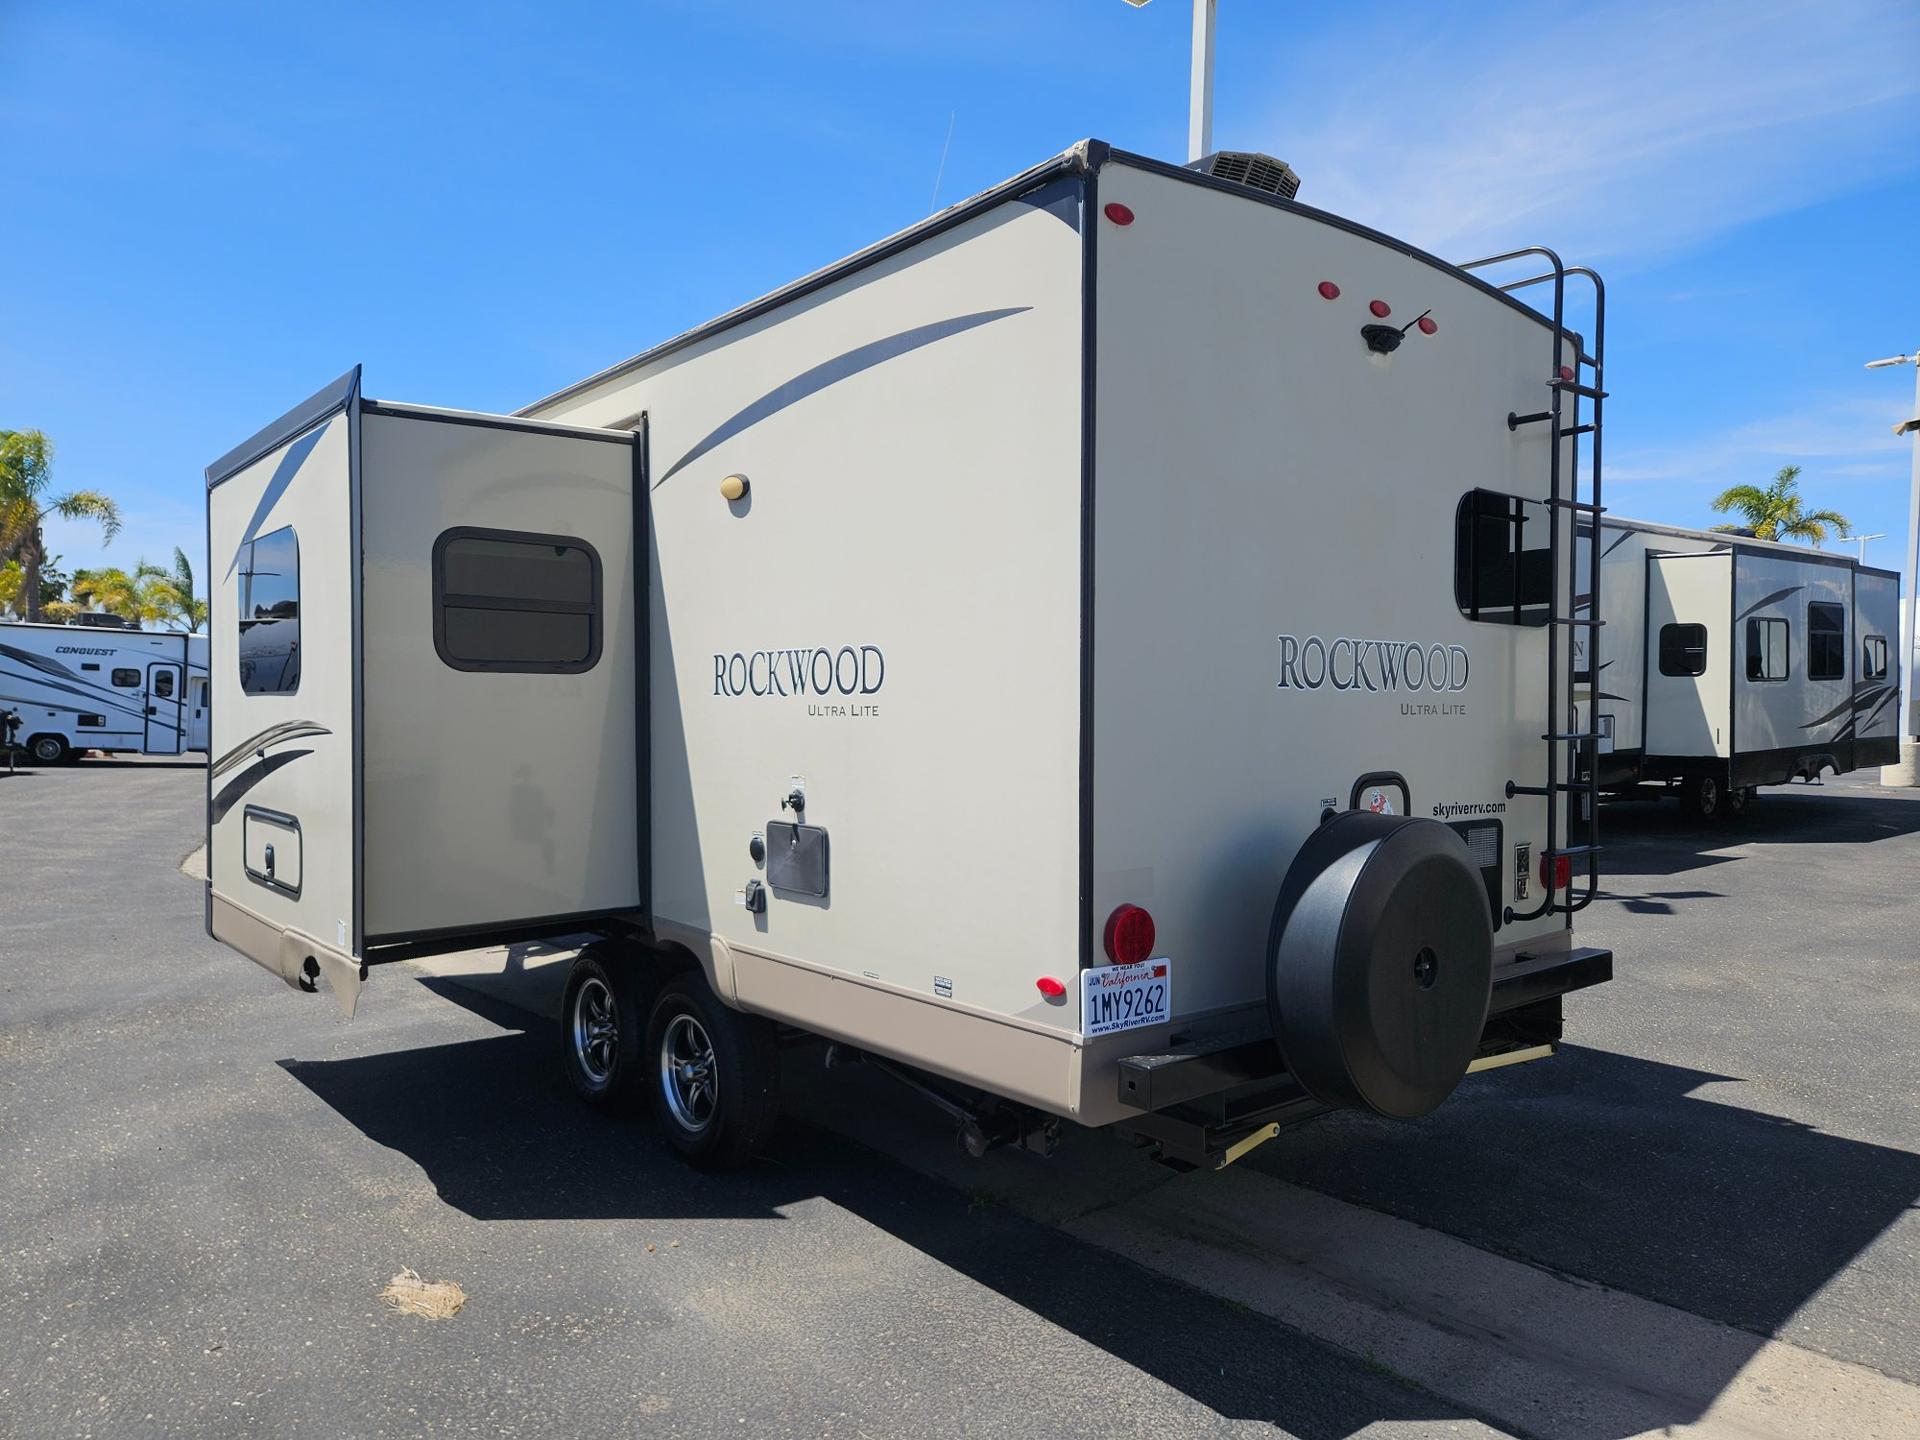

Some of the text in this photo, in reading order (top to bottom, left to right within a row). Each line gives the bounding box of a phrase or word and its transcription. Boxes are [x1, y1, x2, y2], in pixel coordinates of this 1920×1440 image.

[55, 646, 117, 656] CONQUEST
[713, 645, 884, 696] ROCKWOOD
[1277, 635, 1470, 692] ROCKWOOD
[1432, 802, 1506, 819] skyriverrv.com
[1102, 971, 1152, 989] California
[1091, 984, 1164, 1025] 1MY9262
[1092, 1014, 1165, 1033] www.SkyRiverRV.com
